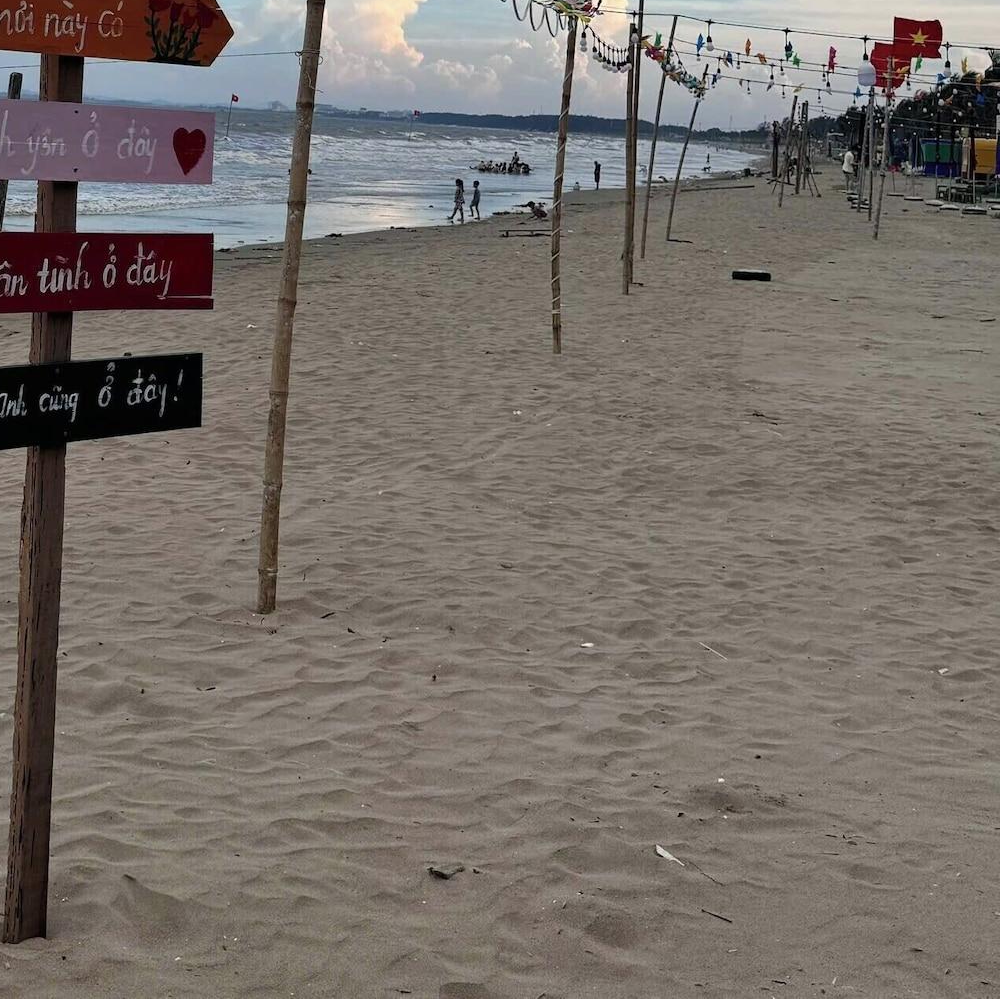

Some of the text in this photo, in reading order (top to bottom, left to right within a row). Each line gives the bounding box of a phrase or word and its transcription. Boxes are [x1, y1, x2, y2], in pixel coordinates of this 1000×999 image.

[43, 0, 88, 53] này
[20, 128, 67, 176] yên
[116, 120, 158, 176] đây
[36, 241, 93, 294] tình
[102, 242, 118, 289] ở
[126, 241, 175, 300] đây
[38, 386, 79, 423] cũng
